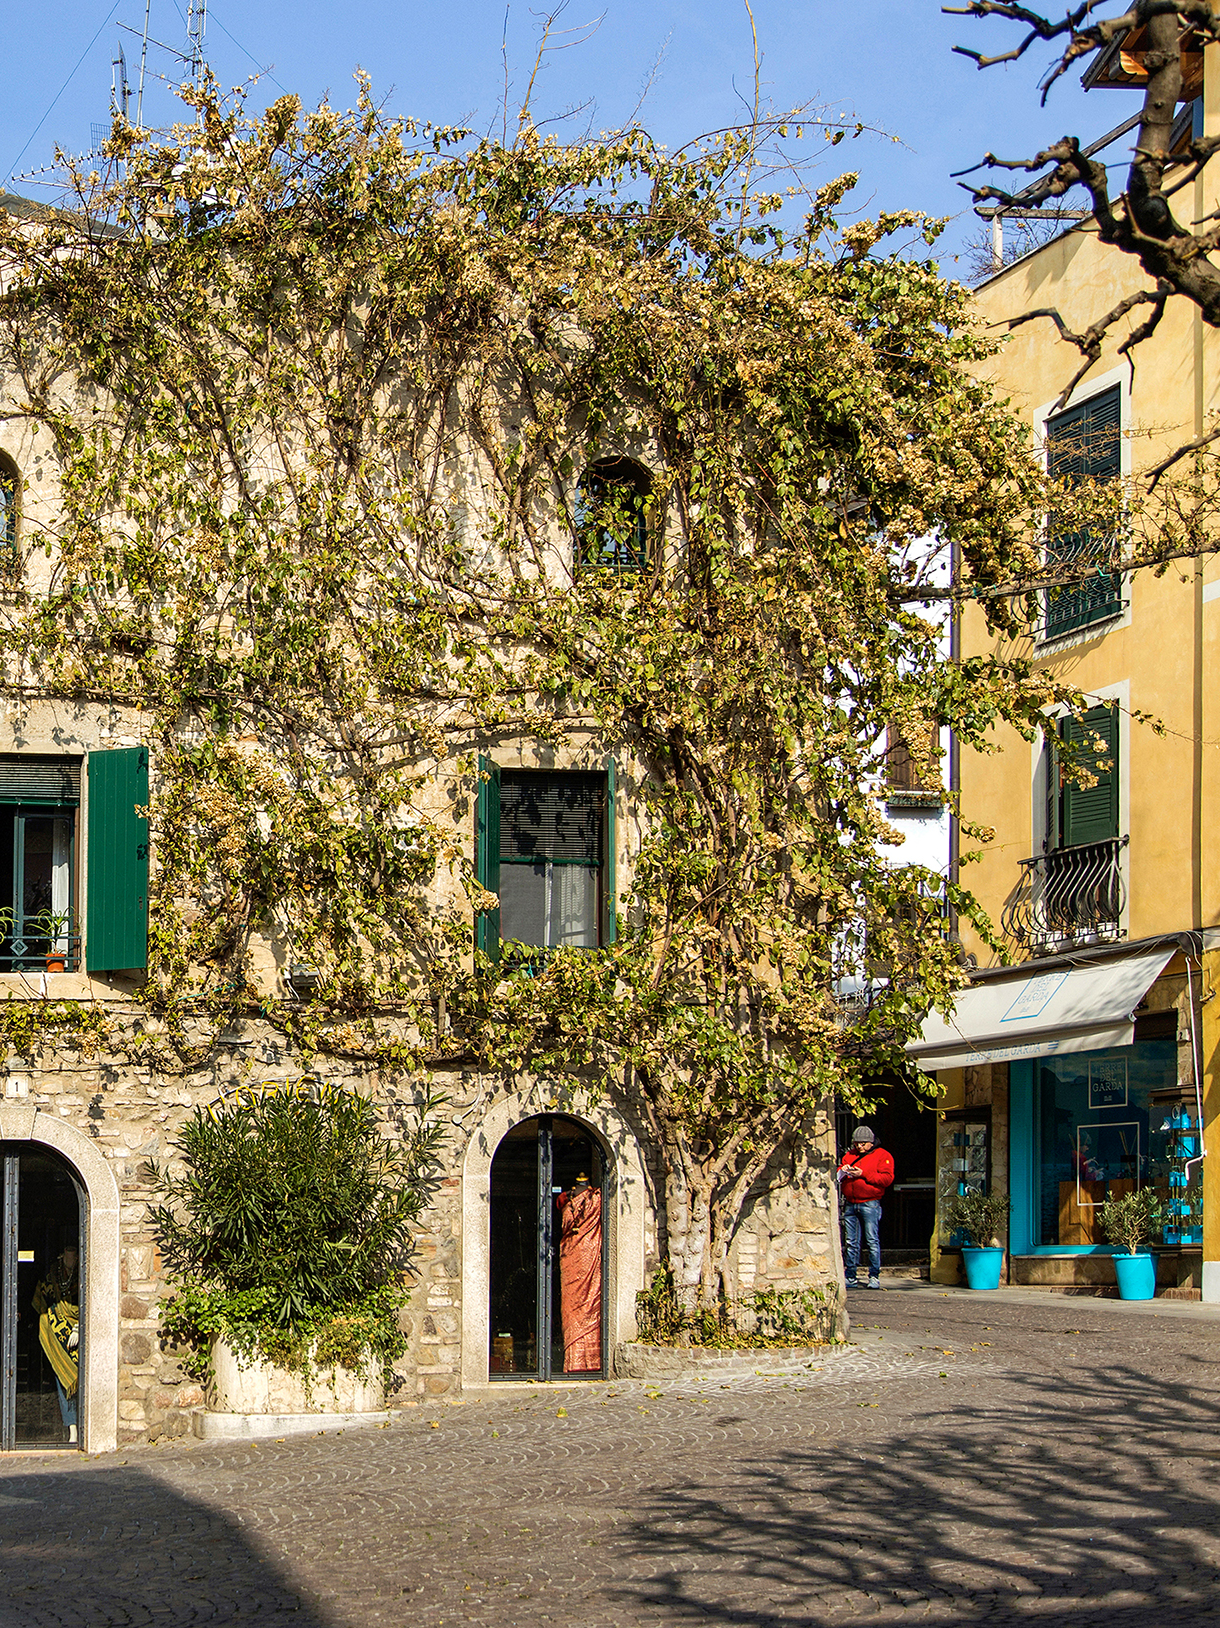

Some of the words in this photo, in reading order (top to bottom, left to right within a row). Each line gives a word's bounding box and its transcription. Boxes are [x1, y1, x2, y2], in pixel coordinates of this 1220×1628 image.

[1018, 991, 1050, 1004] GARDA
[965, 1048, 992, 1062] TERRE
[993, 1046, 1011, 1059] DEL
[1011, 1042, 1041, 1056] GARDA
[1093, 1062, 1123, 1073] TERRE
[1100, 1071, 1117, 1081] DEL
[14, 1081, 19, 1092] 1
[1092, 1081, 1124, 1092] GARDA
